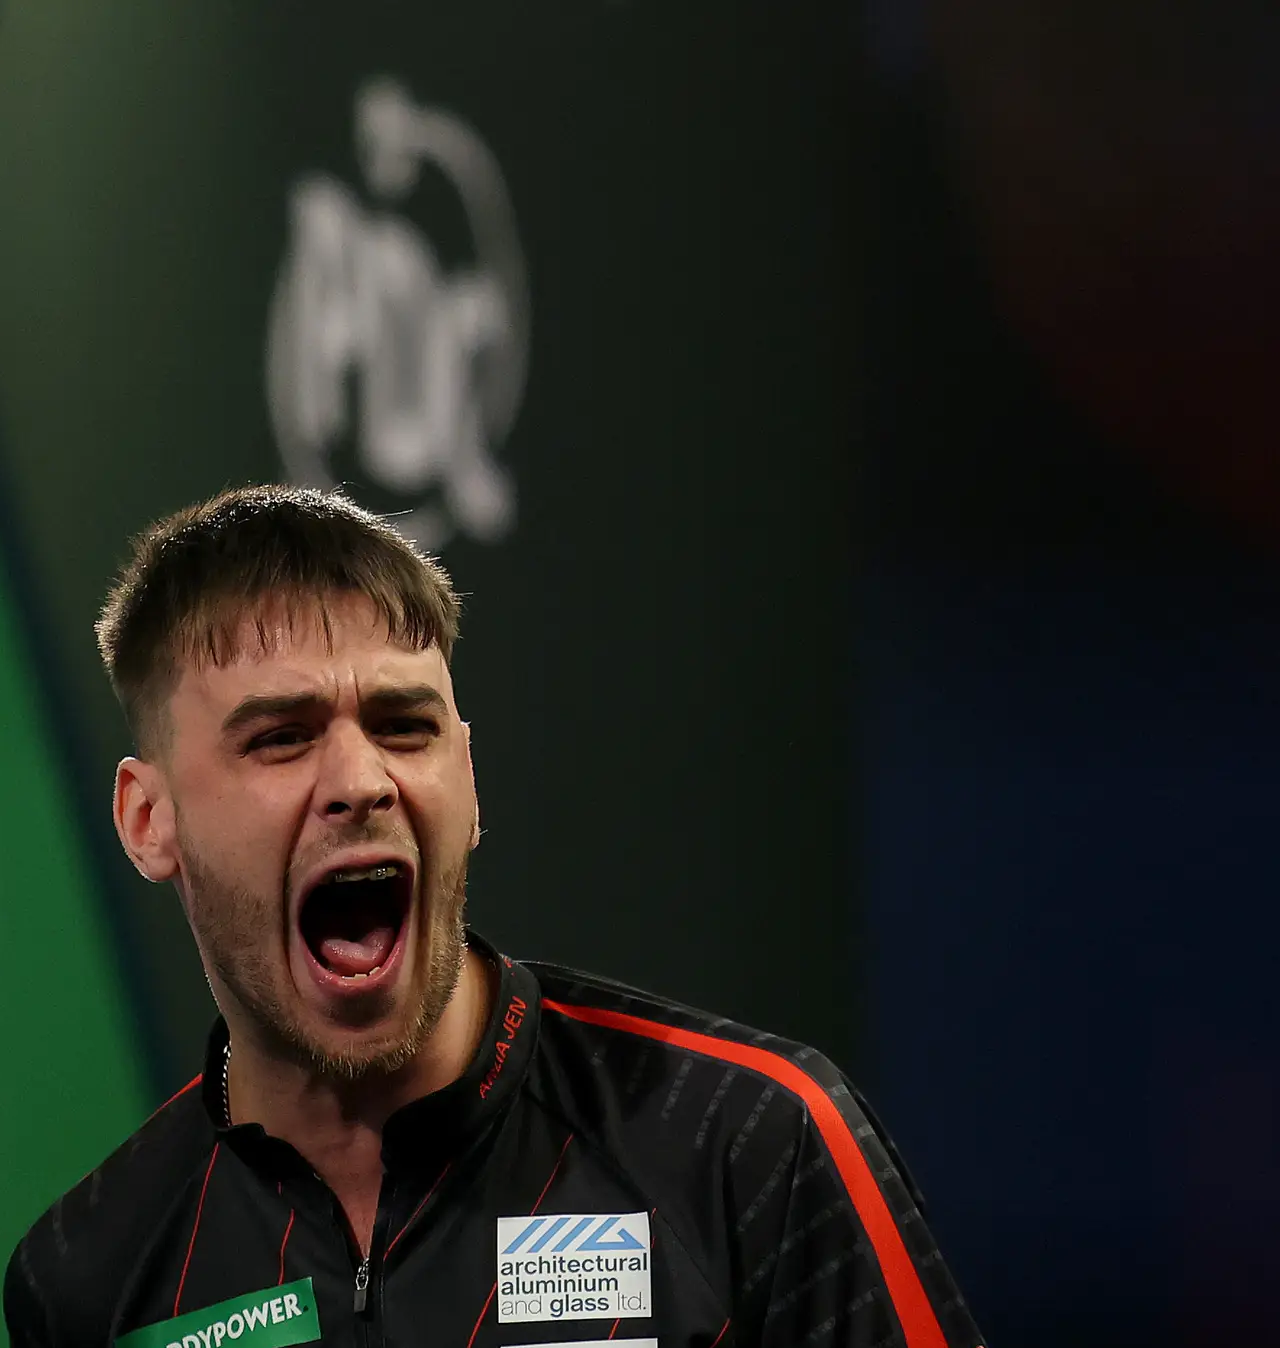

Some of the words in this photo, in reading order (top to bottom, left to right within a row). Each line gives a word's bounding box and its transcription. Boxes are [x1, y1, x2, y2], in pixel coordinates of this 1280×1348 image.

[500, 1252, 648, 1276] architectural
[501, 1274, 619, 1296] aluminium
[501, 1295, 543, 1316] and
[550, 1294, 610, 1318] glass
[617, 1291, 648, 1311] ltd.
